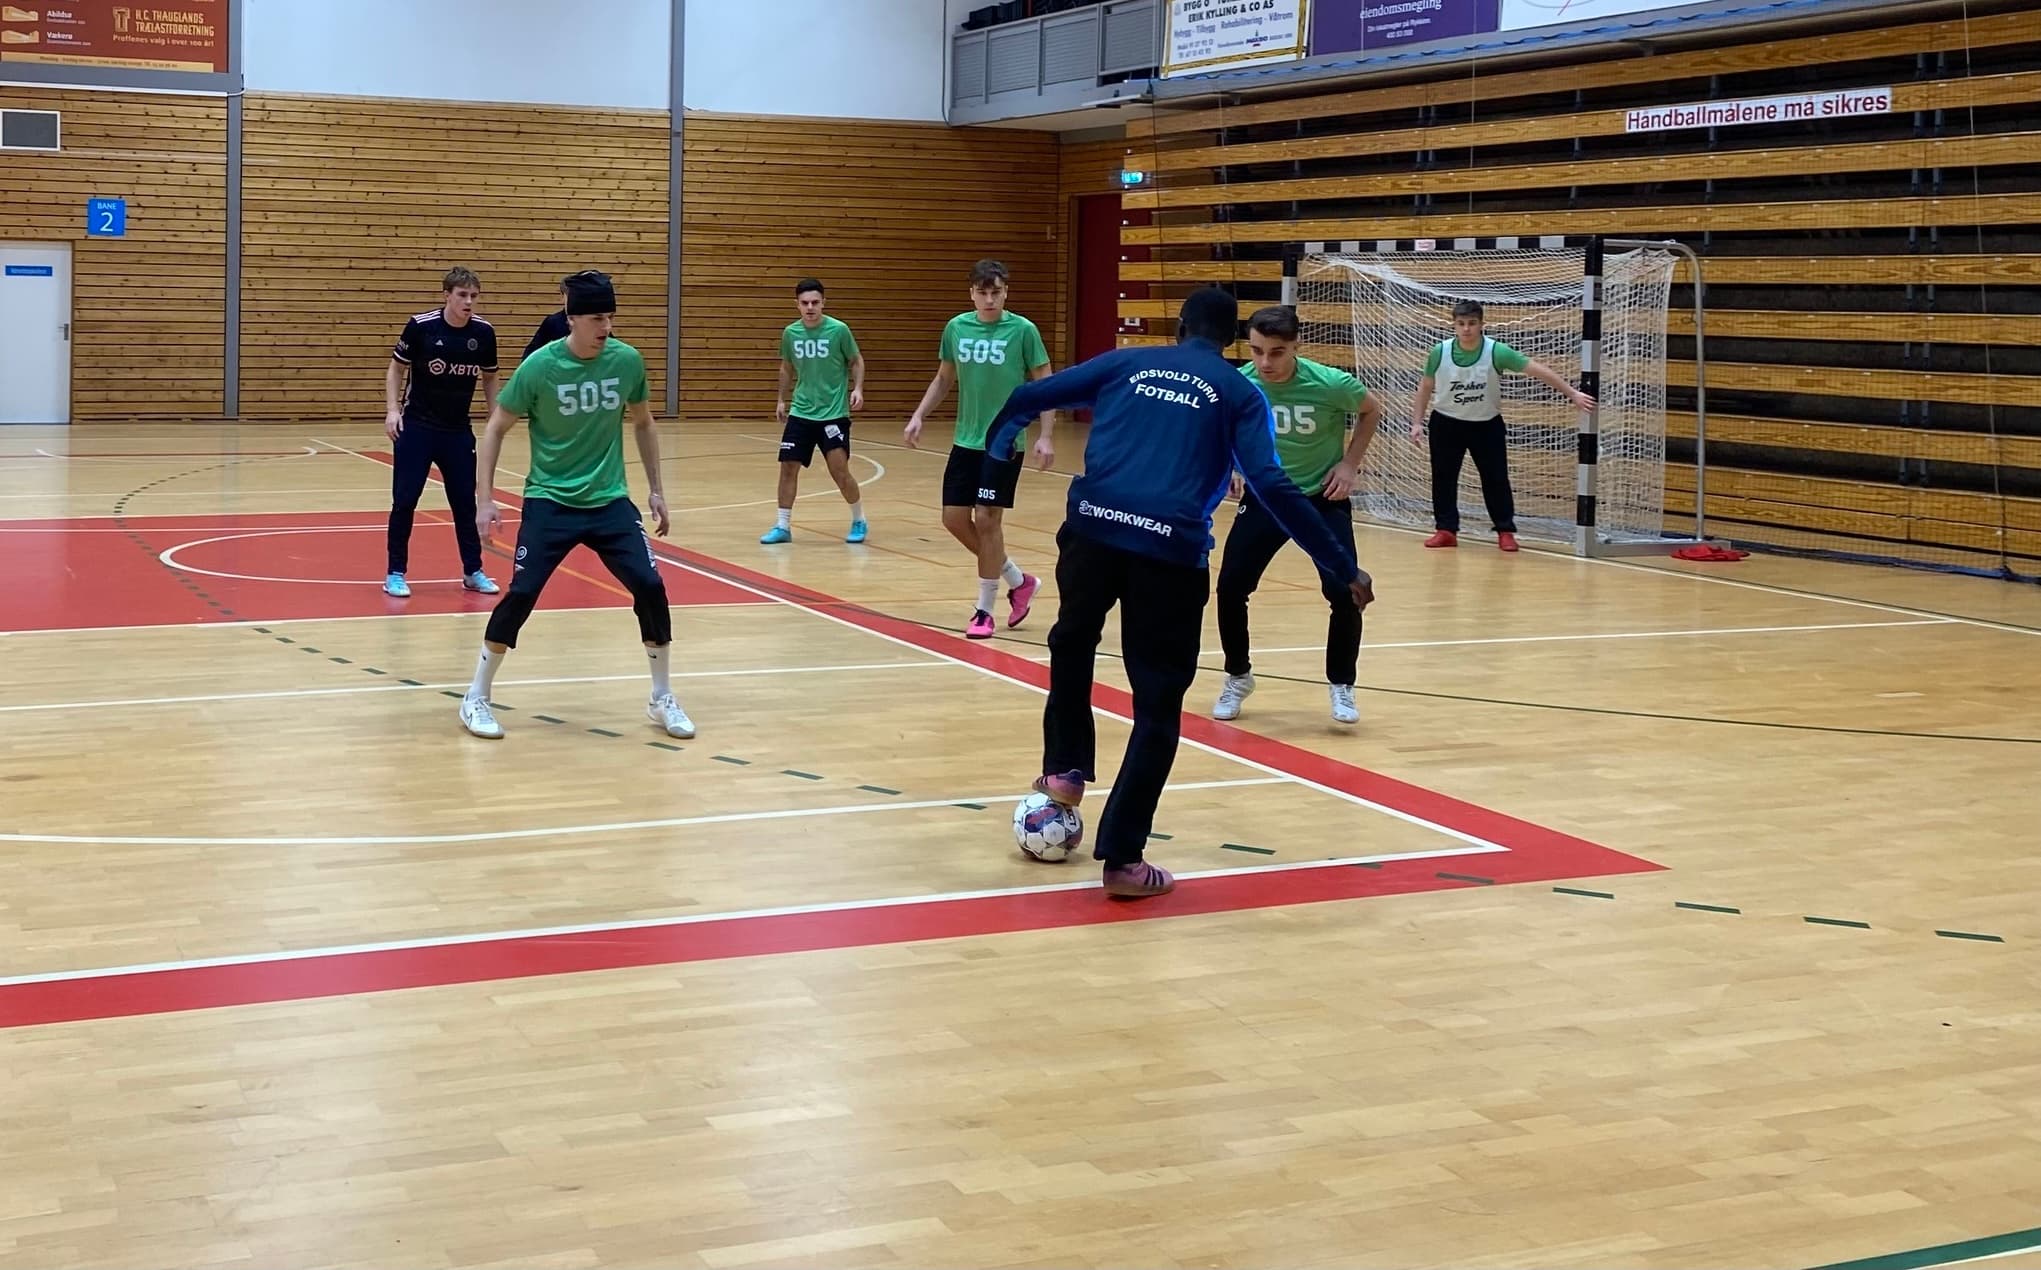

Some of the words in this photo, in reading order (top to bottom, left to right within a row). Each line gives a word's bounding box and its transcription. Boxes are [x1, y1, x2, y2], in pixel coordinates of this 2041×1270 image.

[136, 9, 150, 21] H.C.
[152, 10, 204, 24] THAUGLANDS
[1188, 11, 1204, 23] ERIK
[1205, 5, 1238, 20] KYLLING
[1240, 4, 1247, 13] &
[1249, 1, 1260, 12] CO
[1263, 0, 1275, 9] AS
[1360, 0, 1442, 19] eiendomsmegling
[135, 21, 215, 37] TRÆLASTFORRETNING
[113, 34, 149, 44] Proffenes
[150, 37, 166, 46] valg
[1627, 101, 1777, 130] Håndballmålene
[1784, 97, 1814, 118] må
[1821, 94, 1888, 114] sikres
[97, 202, 117, 210] BANE
[100, 212, 113, 232] 2
[793, 339, 830, 359] 505
[958, 338, 1007, 365] 505
[449, 363, 480, 376] XBTO
[1129, 369, 1190, 384] EIDSVOLD
[1191, 375, 1219, 403] TURN
[1135, 383, 1200, 409] FOTBALL
[557, 377, 620, 416] 505
[1453, 392, 1485, 406] Sport
[1271, 405, 1316, 434] 05
[977, 487, 996, 500] 505
